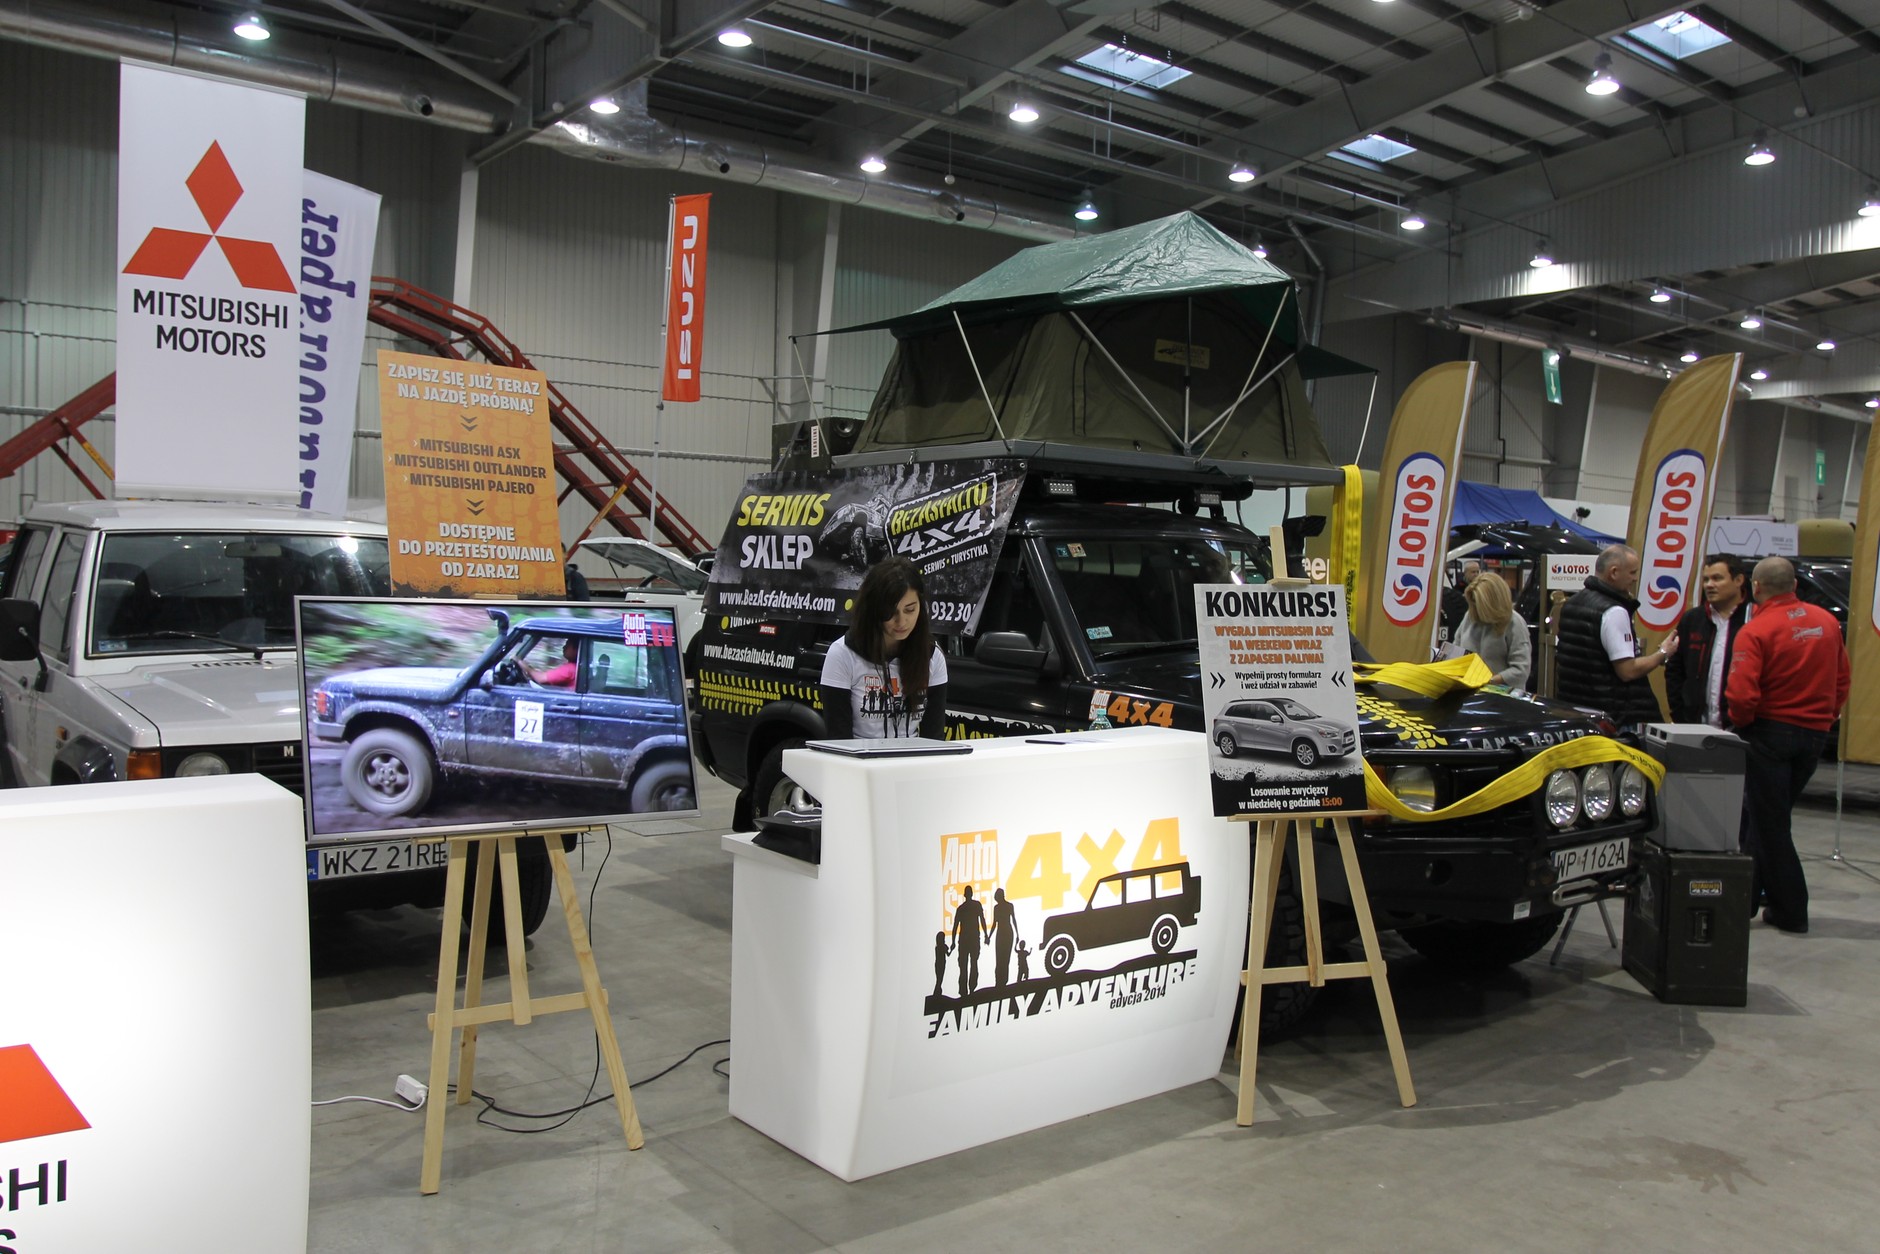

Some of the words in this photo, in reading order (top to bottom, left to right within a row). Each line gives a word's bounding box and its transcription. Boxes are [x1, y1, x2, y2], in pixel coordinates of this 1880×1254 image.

[133, 289, 289, 329] MITSUBISHI
[678, 215, 698, 379] ISUZU
[157, 325, 266, 358] MOTORS
[388, 363, 439, 383] ZAPISZ
[442, 372, 465, 389] SIĘ
[468, 373, 493, 390] JUŻ
[496, 377, 540, 395] TERAZ
[398, 383, 420, 399] NA
[423, 386, 468, 408] JAZDĘ
[470, 392, 534, 415] PRÓBNĄ!
[420, 438, 494, 457] MITSUBISHI
[497, 446, 521, 459] ASX
[394, 454, 470, 473] MITSUBISHI
[473, 461, 547, 479] OUTLANDER
[410, 473, 485, 491] MITSUBISHI
[488, 480, 535, 495] PAJERO
[737, 493, 831, 527] SERWIS
[1397, 474, 1436, 567] LOTOS
[1654, 471, 1697, 568] LOTOS
[439, 522, 516, 542] DOSTĘPNE
[399, 539, 421, 555] DO
[425, 541, 556, 562] PRZETESTOWANIA
[739, 535, 814, 570] SKLEP
[924, 558, 946, 575] SERWIS
[951, 544, 989, 565] TURYSTYKA
[441, 562, 463, 577] OD
[466, 562, 520, 580] ZARAZ!
[1563, 565, 1590, 574] LOTOS
[719, 588, 836, 613] www.BezAsfaltu4x4.com
[931, 601, 955, 621] 932
[955, 603, 977, 623] 30
[1205, 591, 1338, 618] KONKURS!
[623, 614, 645, 630] Auto
[1214, 626, 1257, 637] WYGRAJ
[1257, 626, 1314, 637] MITSUBISHI
[1315, 626, 1334, 636] ASX
[704, 643, 795, 670] www.bezasfaltu4x4.com
[1229, 640, 1244, 650] NA
[1245, 640, 1292, 650] WEEKEND
[1293, 640, 1323, 650] WRAZ
[1229, 653, 1236, 665] Z
[1237, 653, 1283, 665] ZAPASEM
[1284, 653, 1325, 664] PALIWA!
[1235, 671, 1266, 681] Wypełnij
[1266, 671, 1288, 681] prosty
[1288, 670, 1322, 680] formularz
[1259, 681, 1280, 690] udział
[1288, 681, 1318, 690] zabawie!
[520, 717, 538, 734] 27
[1530, 729, 1586, 748] ROVER
[1238, 801, 1247, 809] w
[1247, 798, 1281, 811] niedzielę
[1282, 800, 1289, 809] o
[1288, 798, 1321, 810] godzinie
[1321, 796, 1343, 807] 15:00
[1250, 786, 1292, 798] Losowanie
[1291, 785, 1329, 798] zwycięzcy
[308, 868, 317, 876] PL
[323, 847, 378, 876] WKZ
[942, 833, 997, 886] Auto
[1557, 851, 1577, 878] WP
[1581, 841, 1626, 873] 1162A
[927, 993, 1038, 1040] FAMILY
[1037, 960, 1198, 1016] ADVENTURE
[1109, 990, 1142, 1010] edycja
[1144, 985, 1166, 1003] 2014
